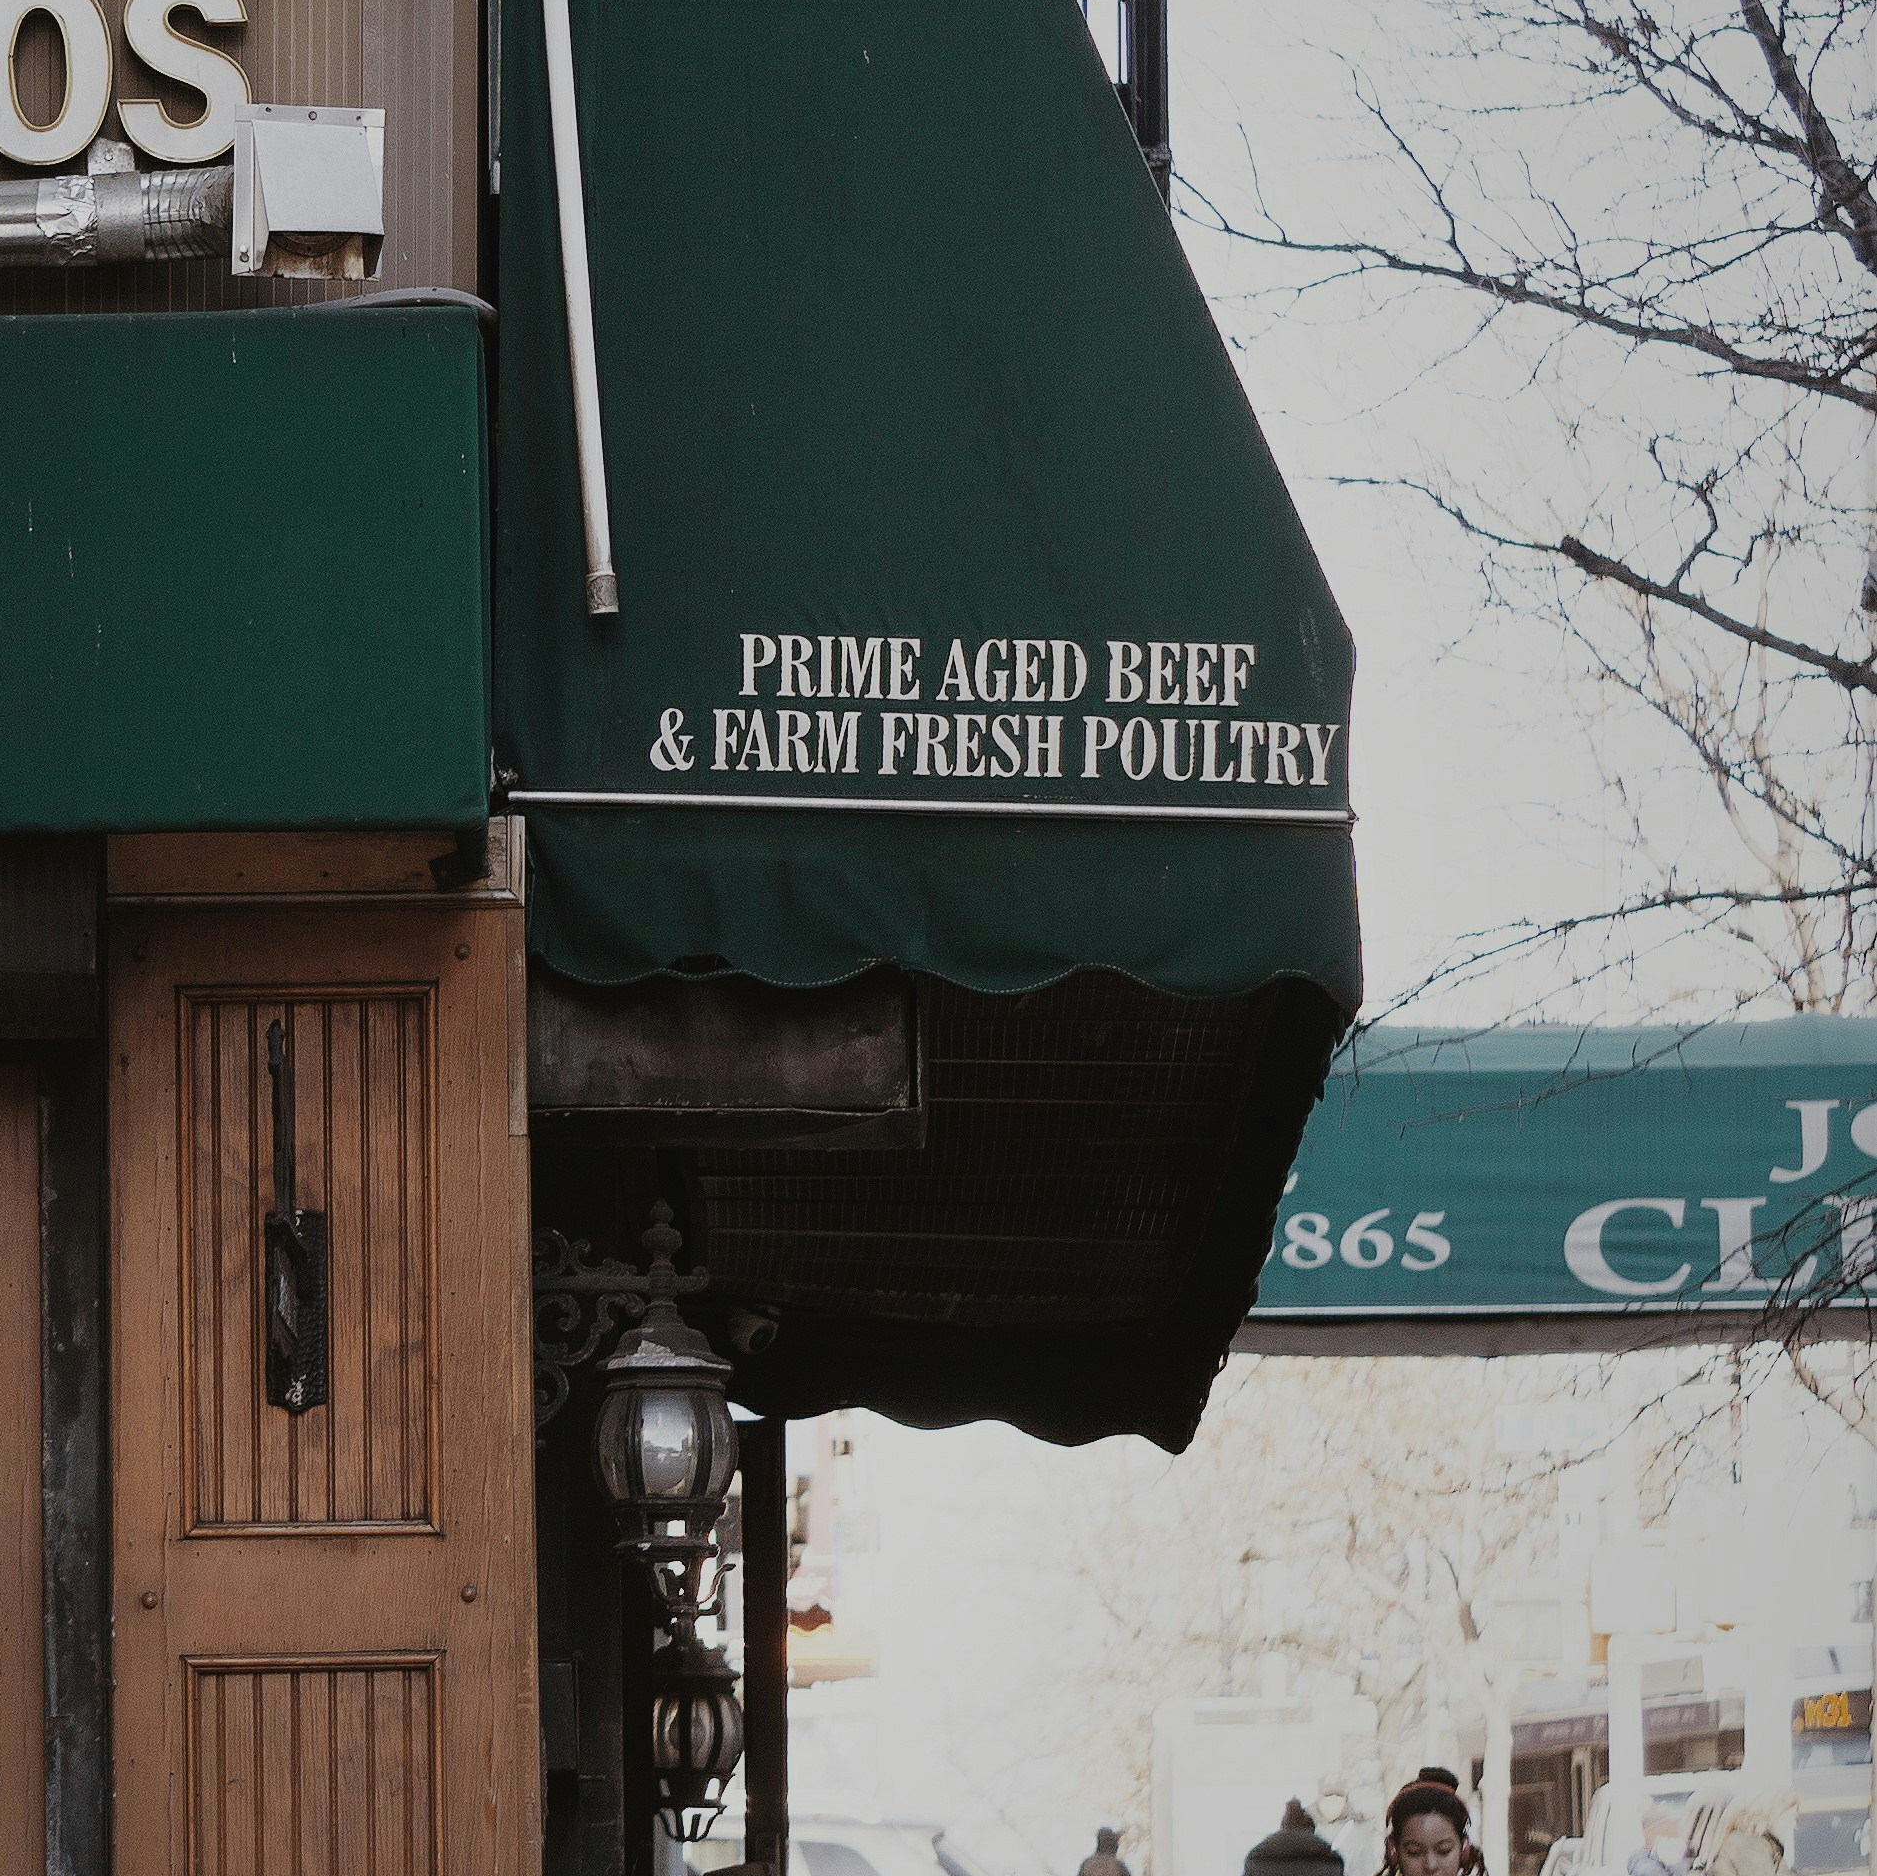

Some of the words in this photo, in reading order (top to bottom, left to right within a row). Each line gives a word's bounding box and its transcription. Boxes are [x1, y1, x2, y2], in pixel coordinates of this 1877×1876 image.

[738, 632, 922, 701] PRIME
[936, 637, 1087, 704] AGED
[1105, 640, 1257, 708] BEEF
[649, 708, 695, 772] &
[711, 709, 859, 774] FARM
[877, 712, 1063, 779] FRESH
[1082, 717, 1340, 787] POULTRY
[1265, 1207, 1451, 1272] 865
